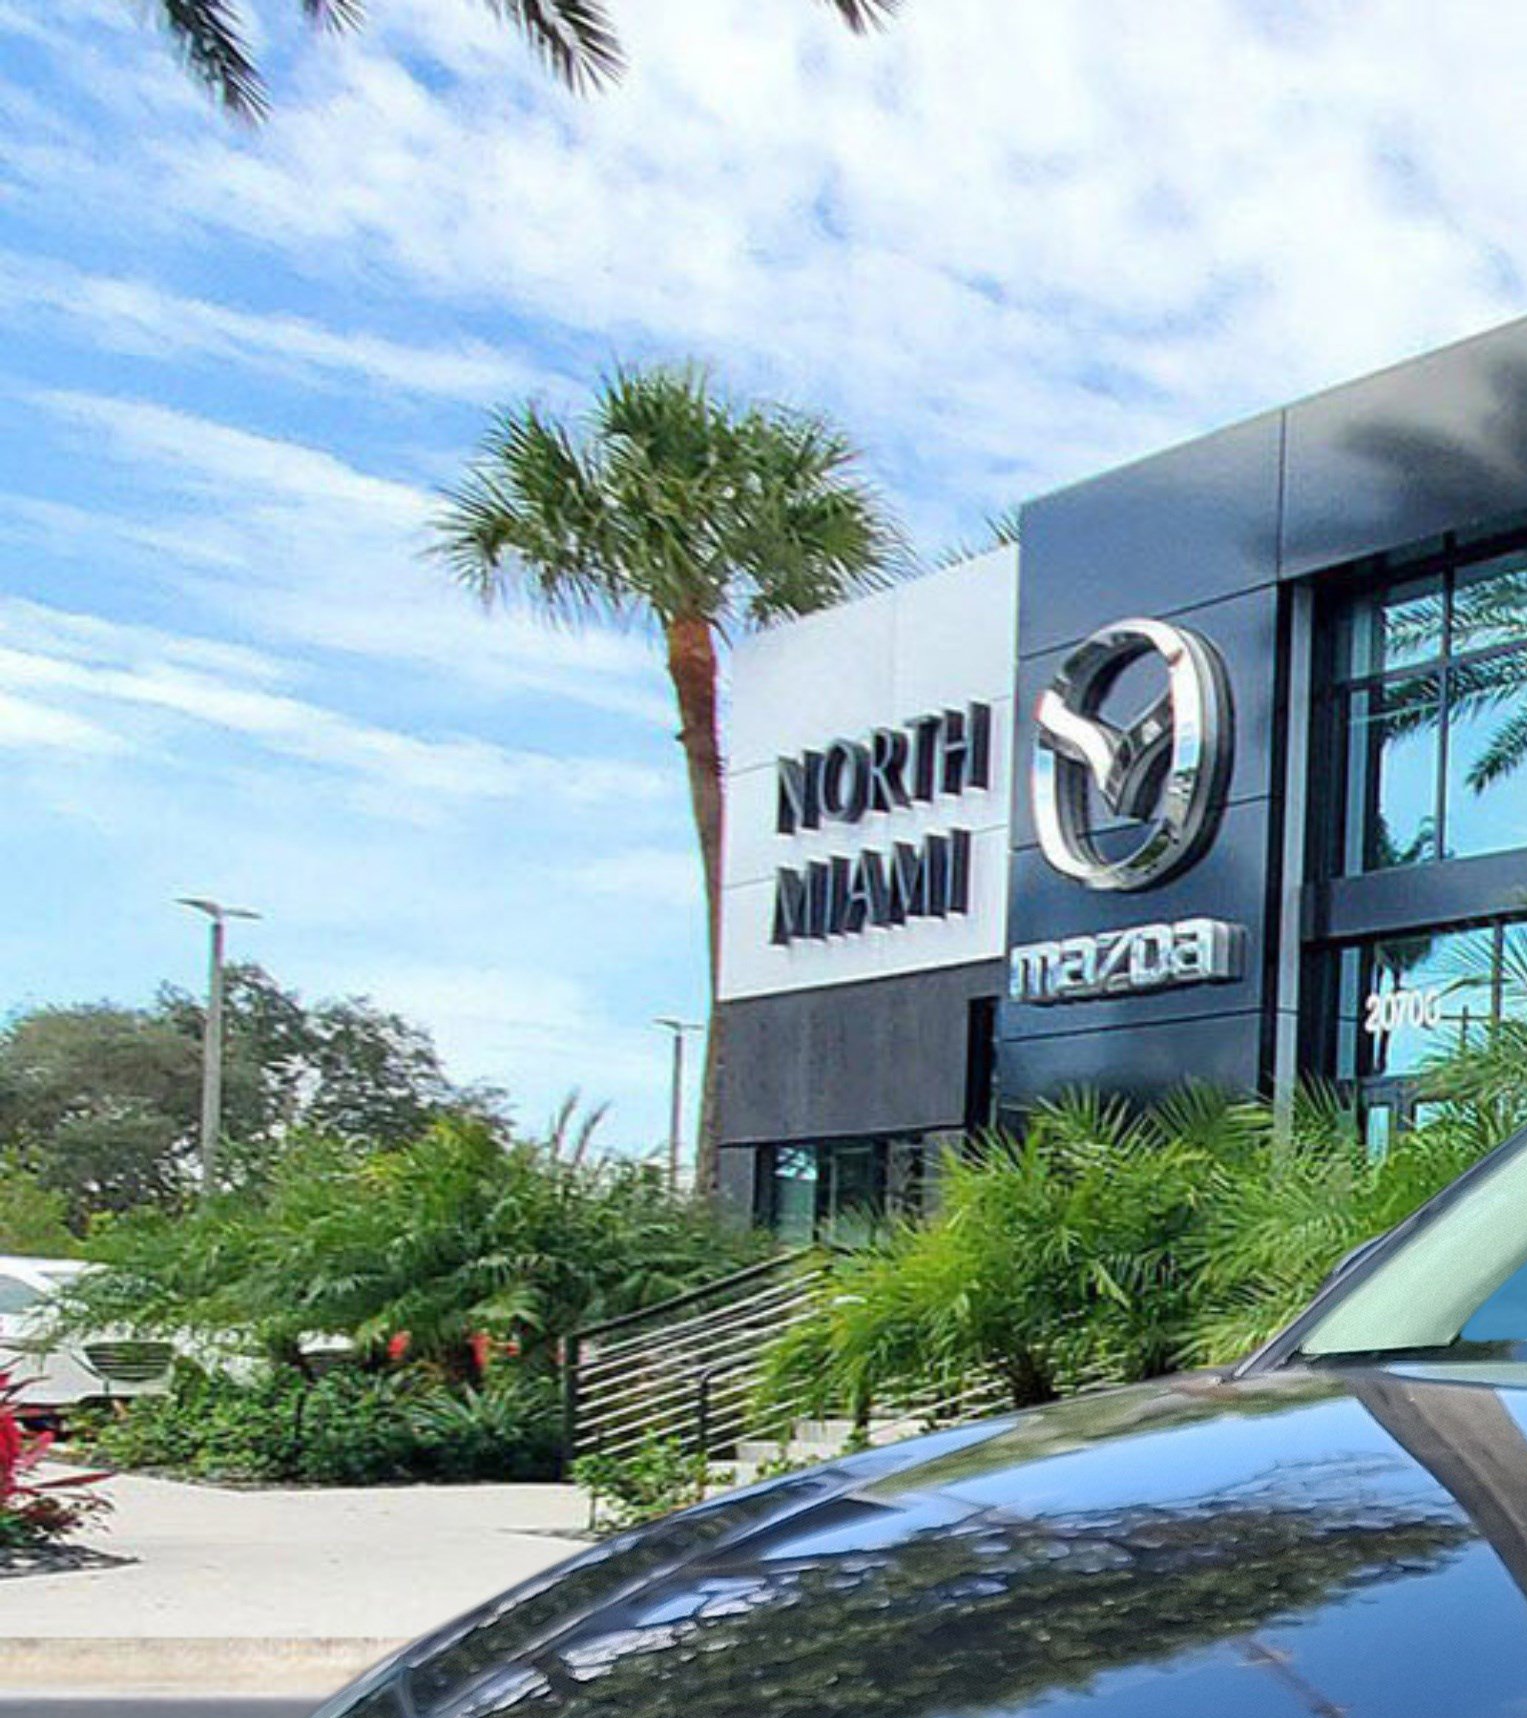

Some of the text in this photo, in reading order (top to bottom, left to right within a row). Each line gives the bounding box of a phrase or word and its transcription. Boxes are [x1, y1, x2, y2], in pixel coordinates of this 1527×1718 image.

[777, 700, 991, 836] NORTH
[772, 828, 972, 946] MIAMI
[1008, 917, 1246, 1003] mazda
